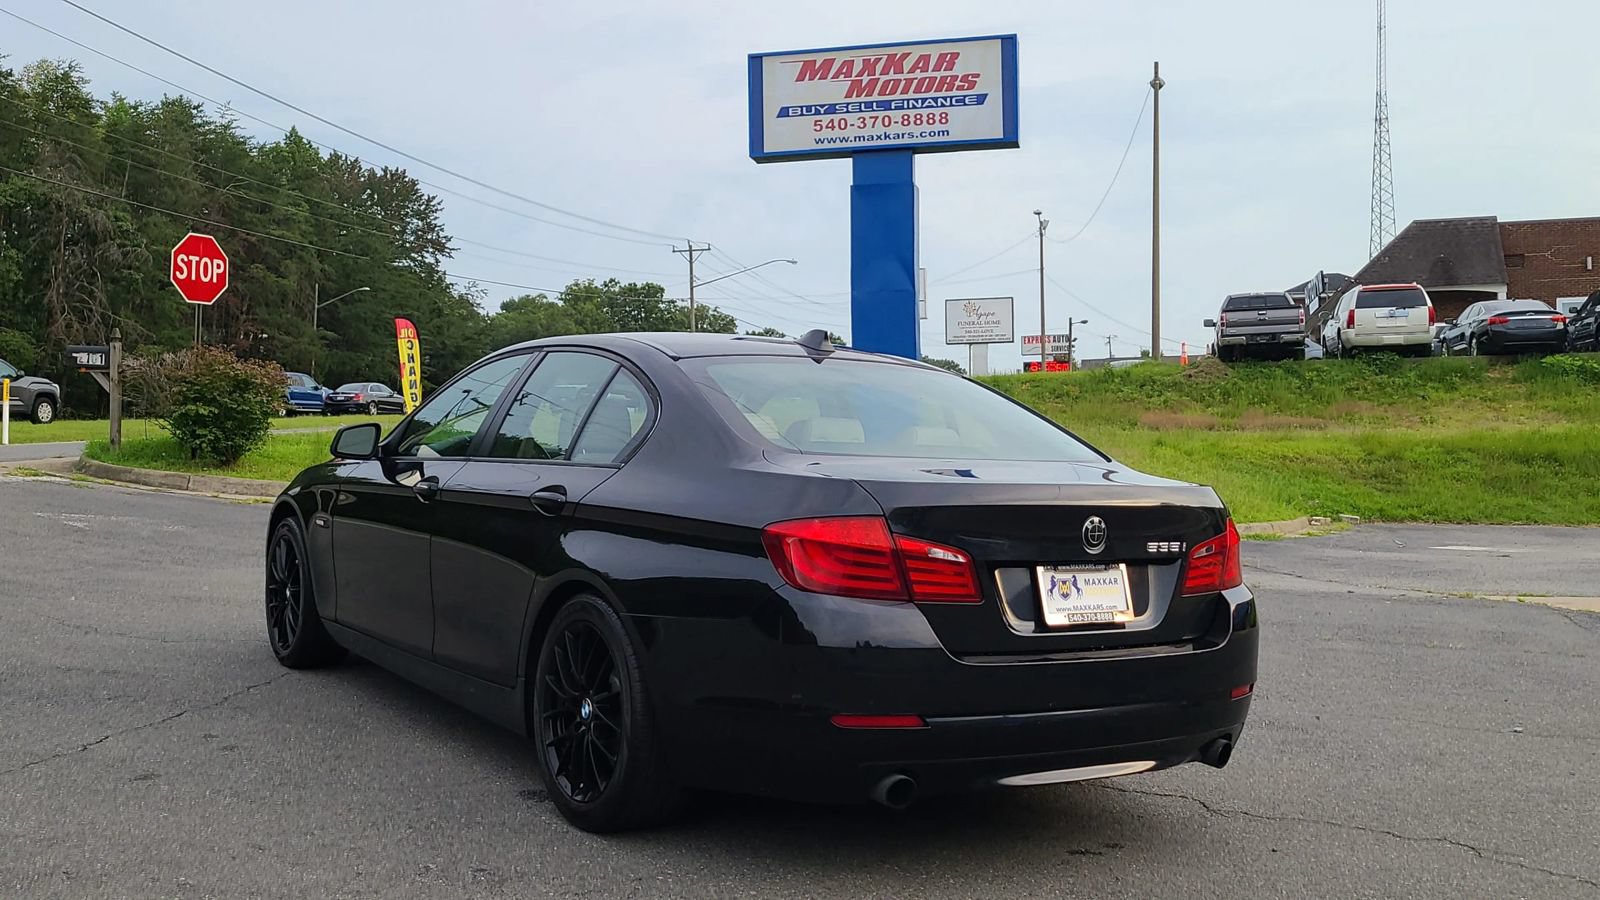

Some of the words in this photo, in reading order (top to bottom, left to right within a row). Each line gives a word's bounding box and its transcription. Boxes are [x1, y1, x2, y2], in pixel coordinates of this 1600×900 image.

[783, 52, 960, 82] MAXKAR
[838, 73, 980, 98] MOTORS
[788, 105, 830, 117] BUY
[835, 101, 885, 113] SELL
[891, 95, 978, 110] FINANCE
[813, 112, 950, 132] 540-370-8888
[814, 128, 950, 145] www.maxkars.com
[176, 254, 225, 283] STOP
[1023, 335, 1051, 345] EXPRS
[1052, 334, 1069, 343] AUTO
[1083, 577, 1119, 586] MAXKAR
